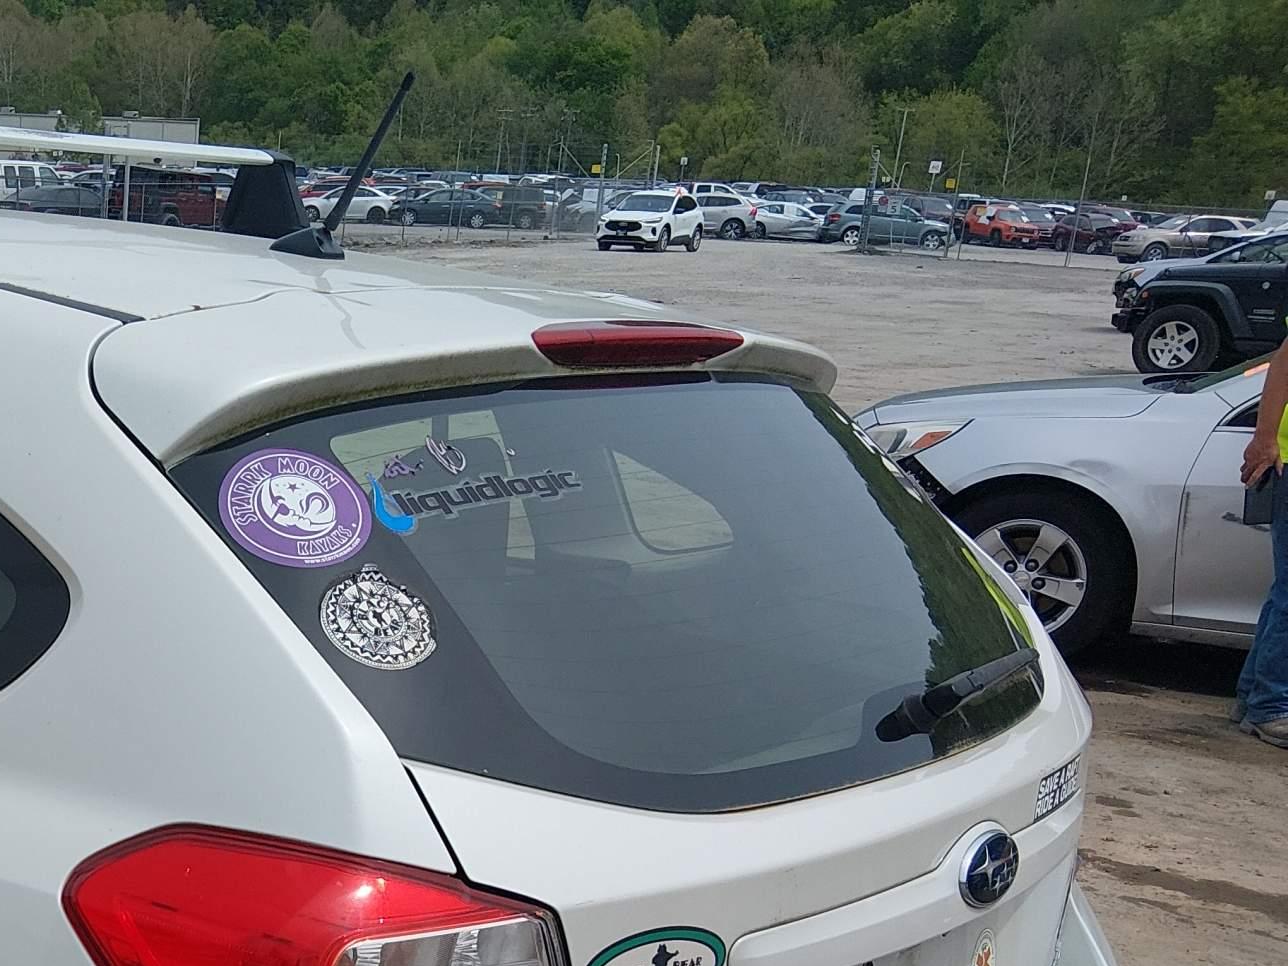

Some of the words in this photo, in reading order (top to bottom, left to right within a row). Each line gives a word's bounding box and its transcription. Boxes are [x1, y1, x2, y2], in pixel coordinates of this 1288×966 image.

[231, 462, 272, 526] STARRK
[277, 456, 341, 490] MOON
[391, 469, 581, 516] liquidlogic
[296, 525, 353, 556] KAYAKS
[1038, 770, 1061, 800] SAVE
[1034, 791, 1055, 819] RIDE
